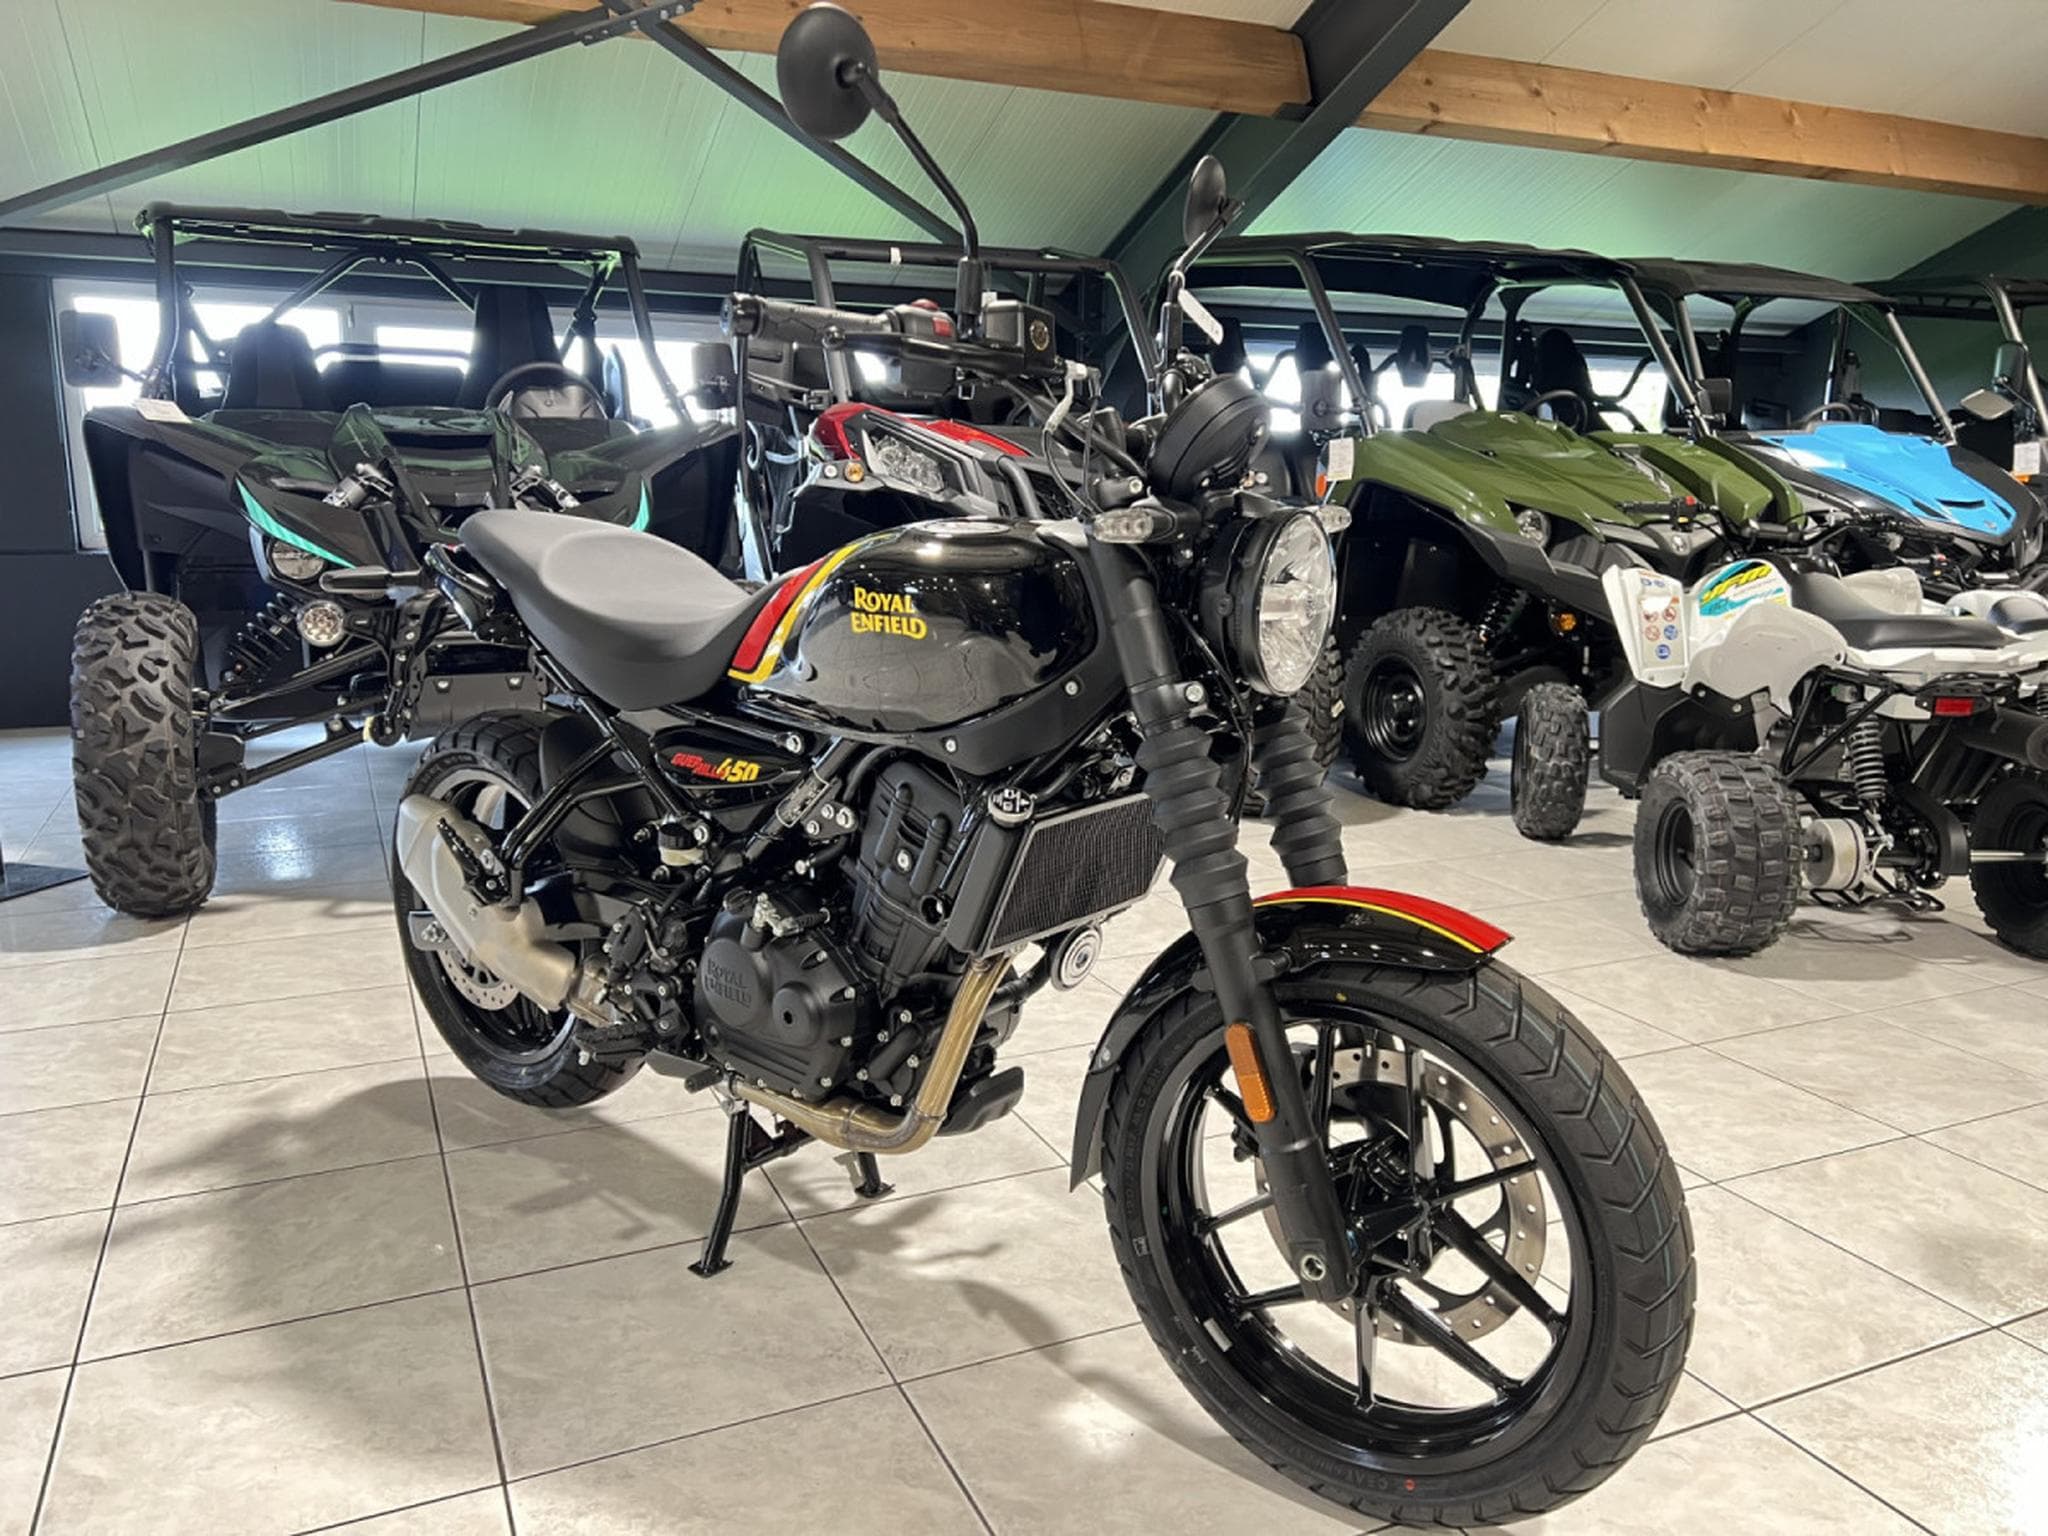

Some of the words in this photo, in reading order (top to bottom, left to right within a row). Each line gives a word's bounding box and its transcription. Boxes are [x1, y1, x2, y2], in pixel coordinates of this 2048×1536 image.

[854, 587, 915, 613] ROYAL
[851, 611, 928, 640] ENFIELD
[716, 757, 761, 782] 450
[708, 958, 748, 989] ROYAL
